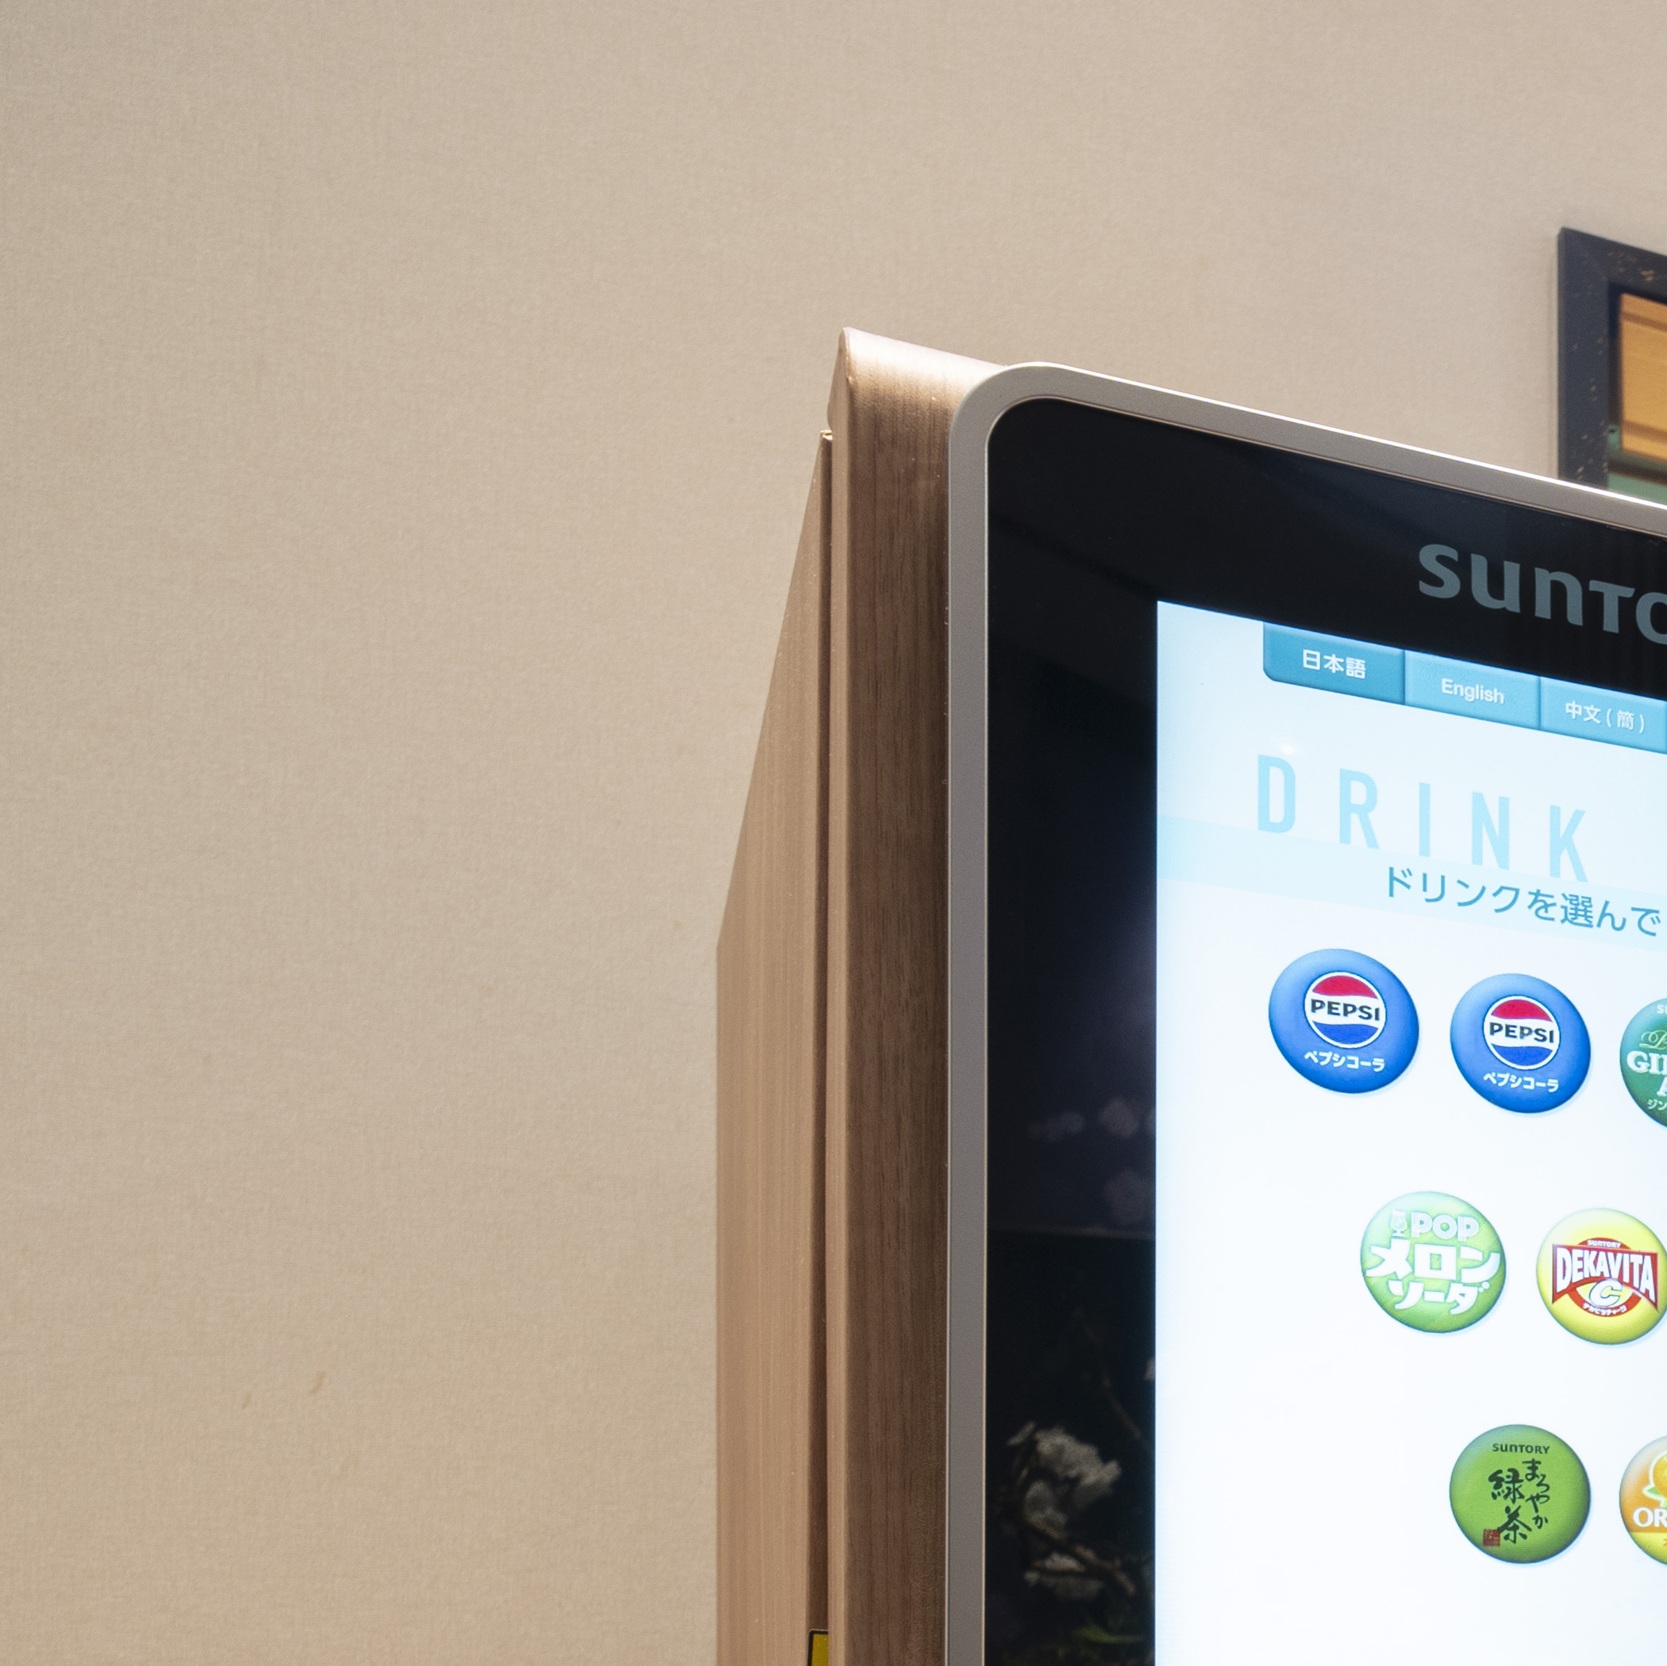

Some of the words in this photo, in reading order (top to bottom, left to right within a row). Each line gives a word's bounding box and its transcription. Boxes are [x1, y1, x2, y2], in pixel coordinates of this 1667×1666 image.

[1302, 648, 1367, 680] 日本語
[1441, 678, 1505, 707] English
[1257, 754, 1588, 882] DRINK
[1311, 998, 1380, 1022] PEPSI
[1489, 1022, 1554, 1044] PEPSI
[1304, 1051, 1385, 1072] ペプシコーラ
[1483, 1071, 1559, 1093] ペプシコーラ
[1410, 1211, 1480, 1242] POP
[1365, 1238, 1500, 1284] メロン
[1555, 1246, 1657, 1303] DEKAVITA
[1387, 1280, 1490, 1315] ソーダ
[1588, 1277, 1624, 1308] C
[1492, 1443, 1550, 1455] SUNTORY
[1487, 1467, 1532, 1545] 緑茶
[1522, 1458, 1551, 1529] まろやか
